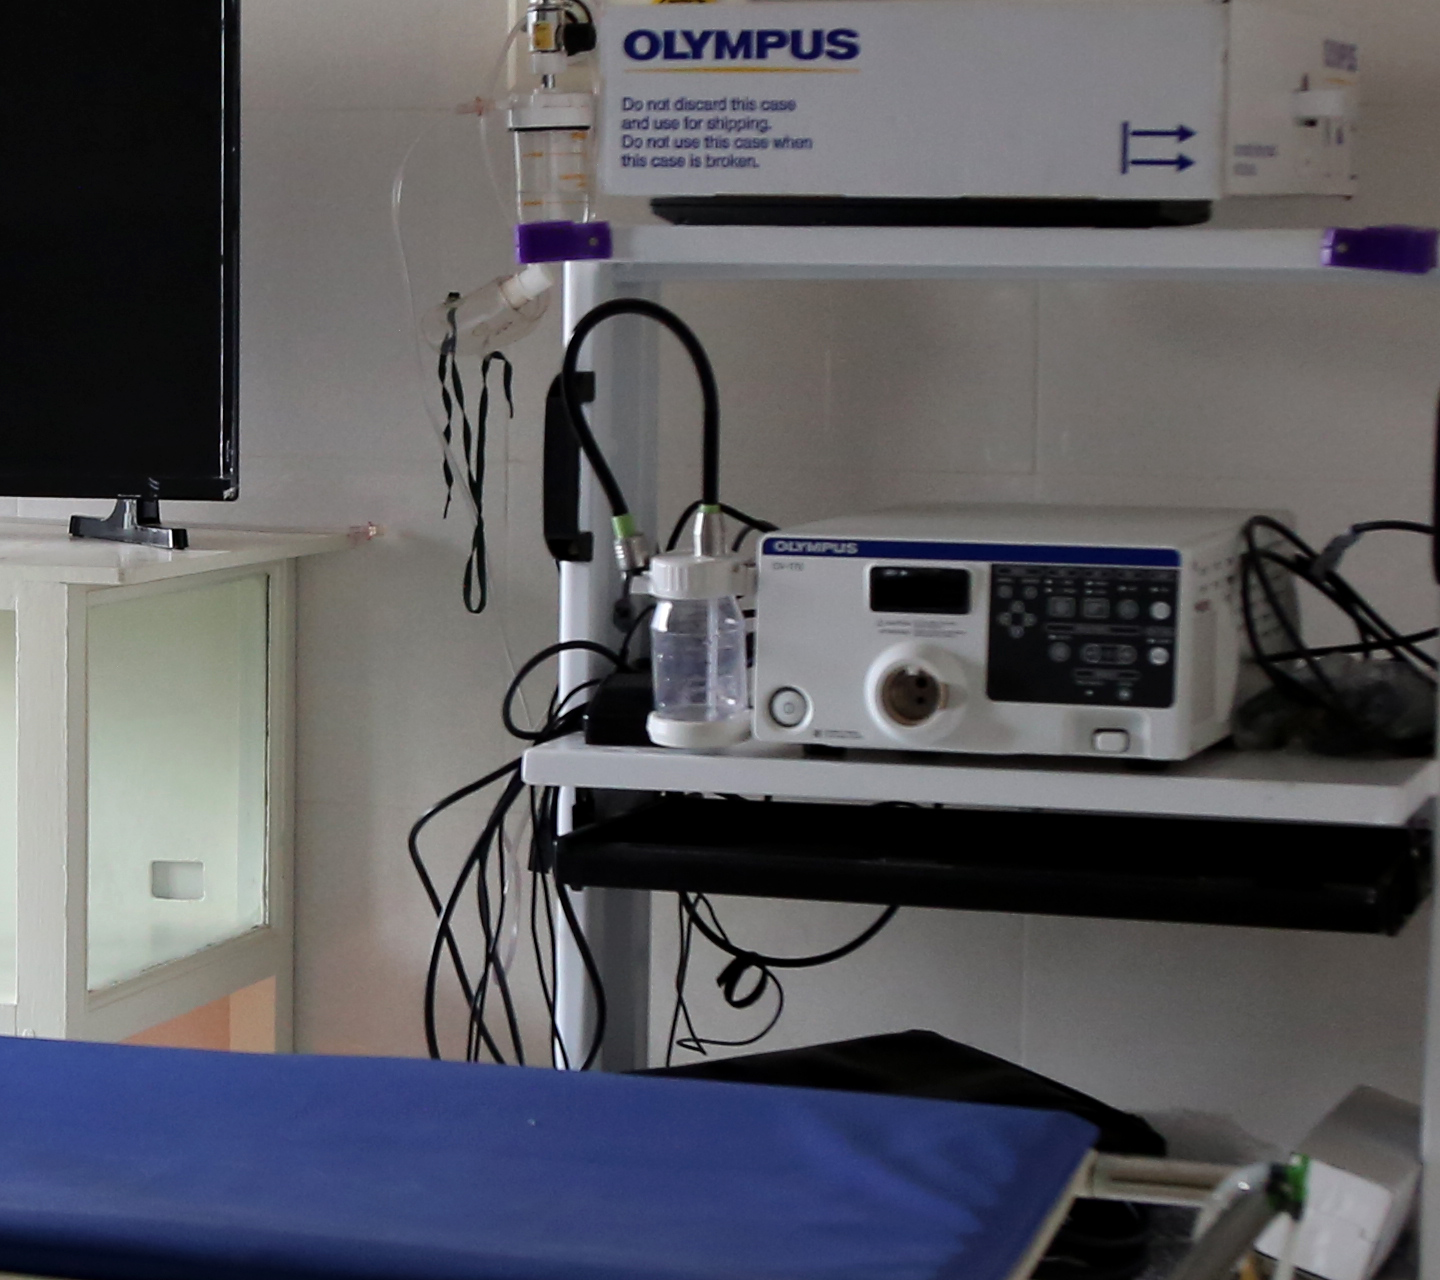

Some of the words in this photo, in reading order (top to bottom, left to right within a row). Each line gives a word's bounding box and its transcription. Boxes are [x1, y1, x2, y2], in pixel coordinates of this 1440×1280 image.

[623, 28, 860, 61] OLYMPUS
[622, 97, 643, 111] Do
[647, 97, 669, 111] not
[674, 97, 727, 111] discard
[731, 97, 757, 111] this
[761, 100, 797, 112] case
[622, 117, 649, 130] and
[654, 119, 679, 130] use
[684, 117, 704, 130] for
[707, 117, 772, 133] shipping.
[622, 136, 643, 149] Do
[647, 136, 669, 149] not
[674, 138, 700, 149] use
[704, 136, 730, 149] this
[734, 138, 769, 150] case
[773, 136, 813, 150] when
[622, 155, 647, 168] this
[650, 157, 686, 168] case
[690, 155, 701, 168] is
[706, 155, 760, 168] broken.
[773, 541, 858, 554] OLYMPUS
